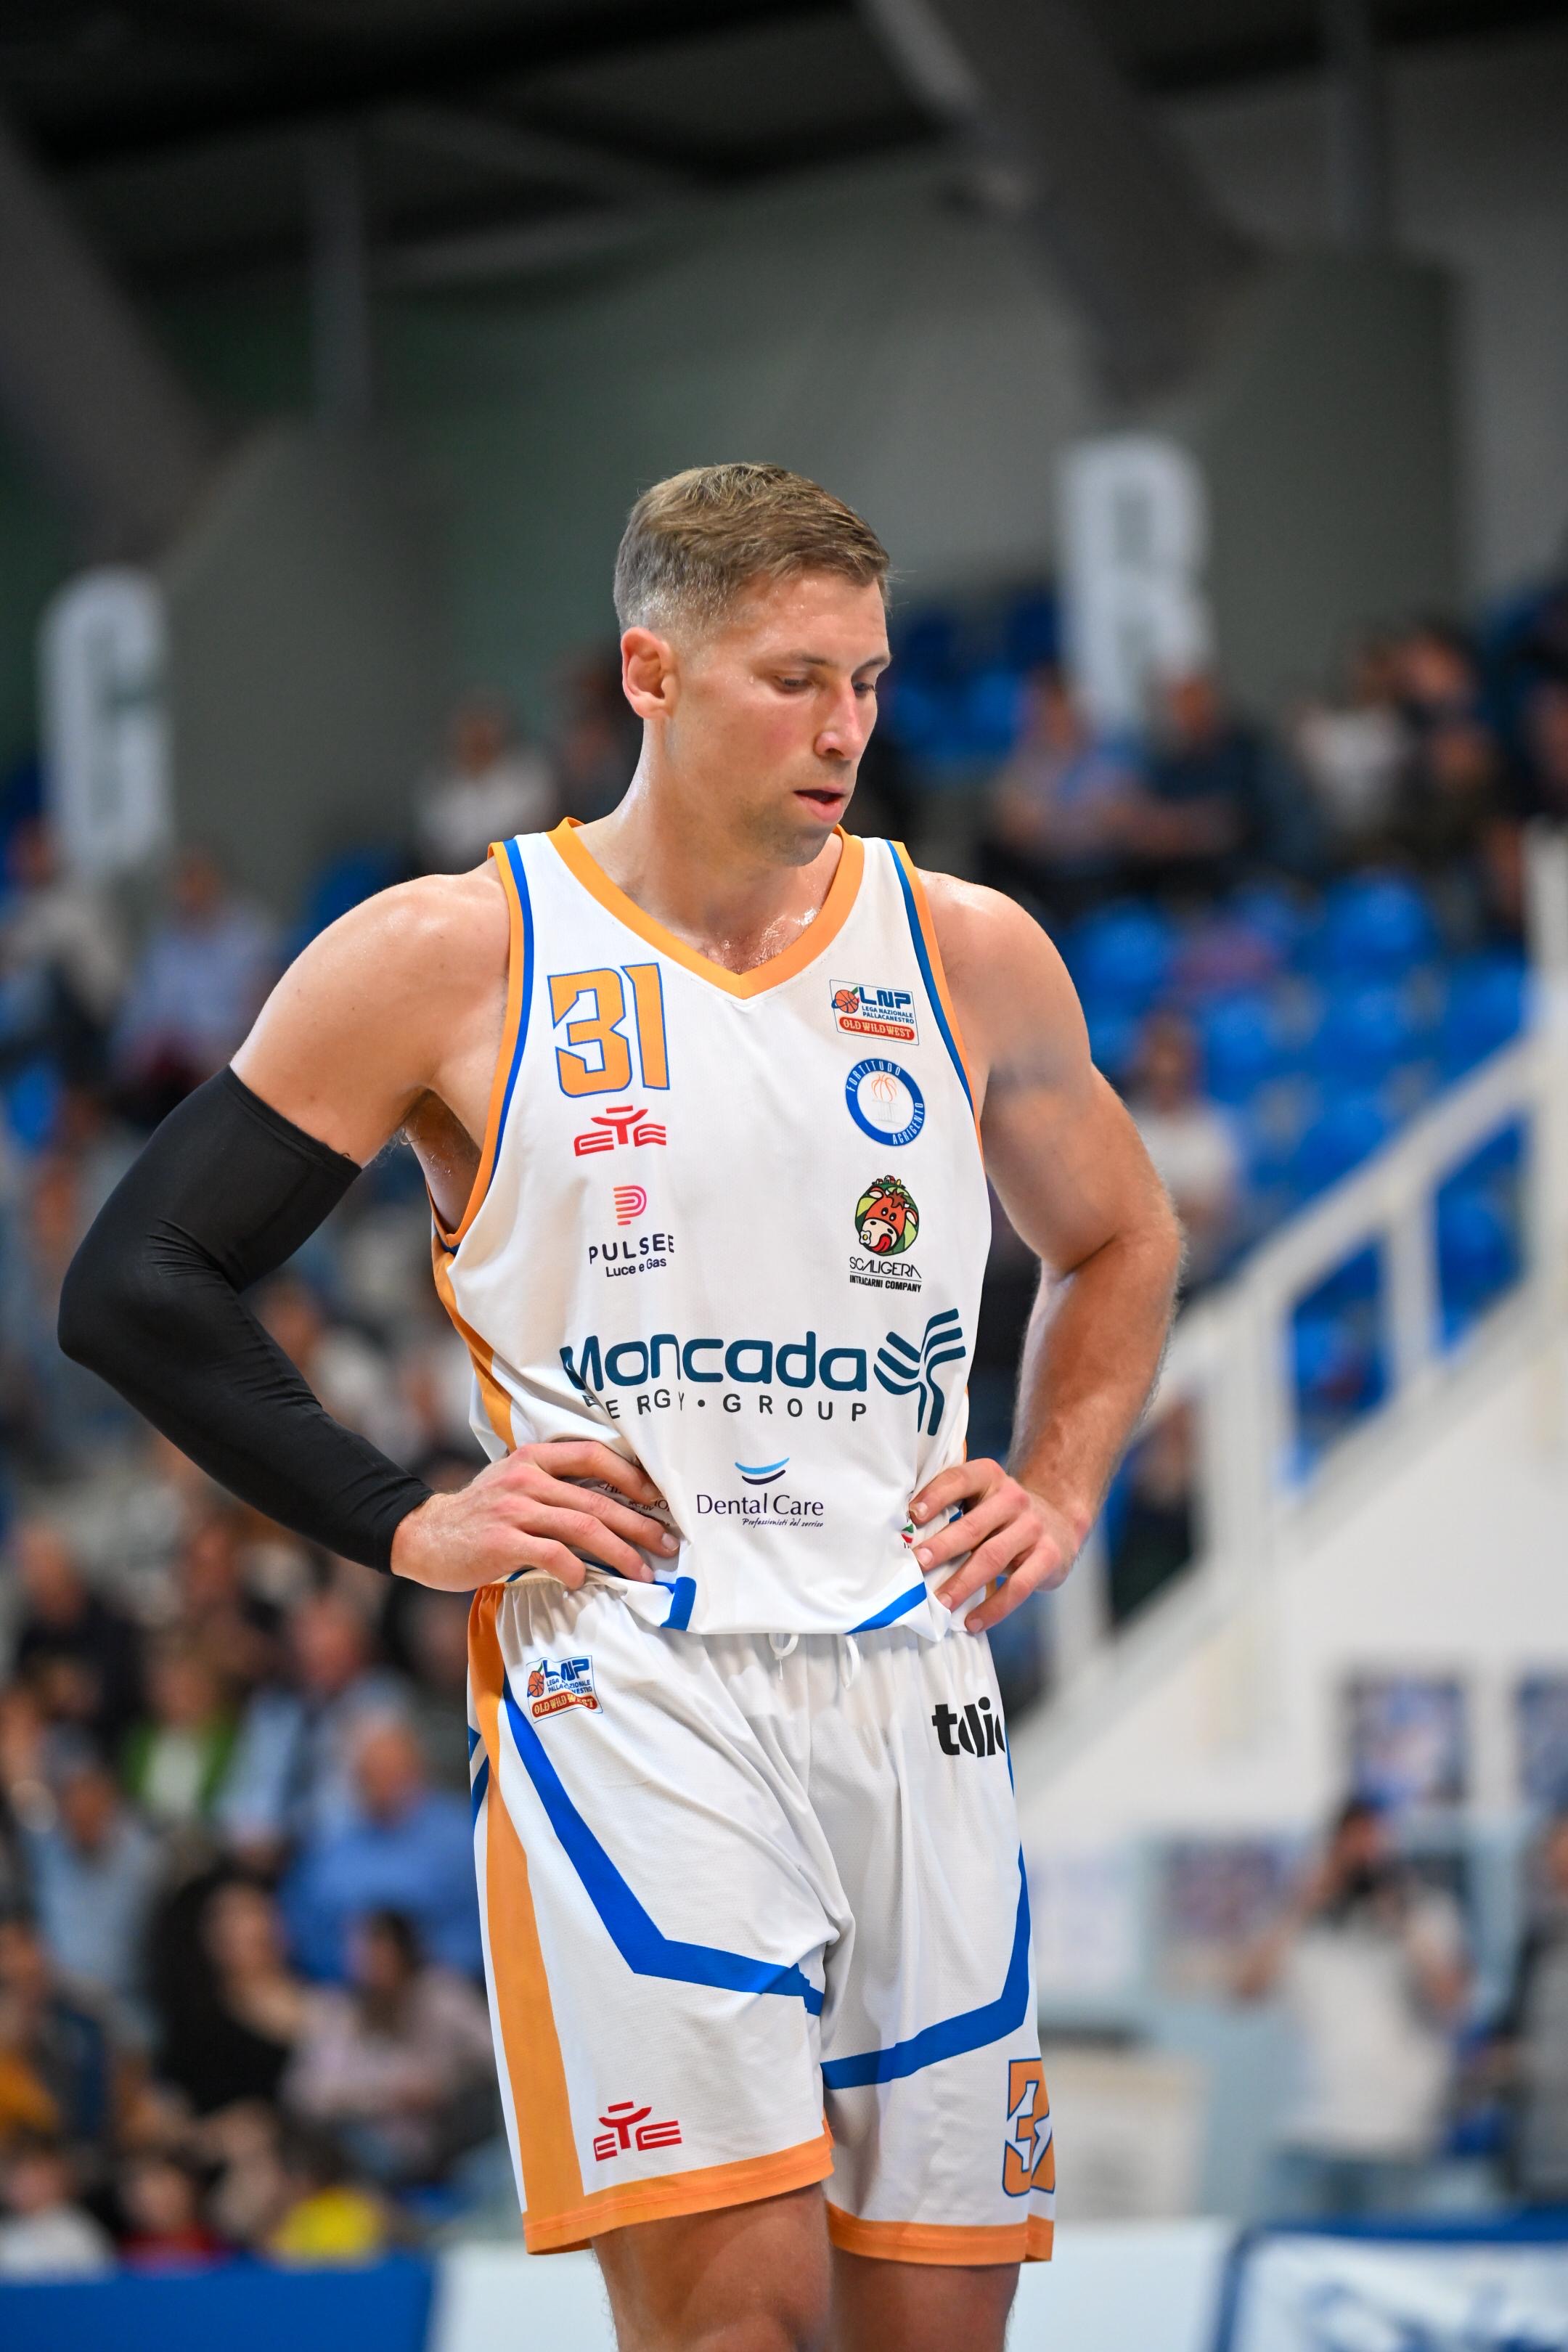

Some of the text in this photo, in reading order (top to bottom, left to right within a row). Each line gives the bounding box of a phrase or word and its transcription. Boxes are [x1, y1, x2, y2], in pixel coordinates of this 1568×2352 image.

[859, 986, 911, 1009] LNP
[862, 1011, 915, 1024] PALLACANESTRO
[879, 1008, 912, 1018] NAZIONALE
[547, 963, 670, 1098] 31
[844, 1019, 912, 1038] OLD WILD WEST
[846, 1061, 900, 1093] FORTITUDO
[589, 1233, 674, 1265] PULSEE
[605, 1258, 667, 1278] Luce e Gas
[849, 1257, 922, 1278] SCALIGERA
[885, 1281, 922, 1293] COMPANY
[560, 1331, 867, 1392] Moncada
[581, 1389, 867, 1421] EERGY GROUP
[696, 1493, 768, 1514] Dental
[772, 1494, 824, 1516] Care
[742, 1517, 788, 1528] Professionisti
[542, 1659, 589, 1681] LNP
[547, 1678, 560, 1687] LEGA
[534, 1702, 550, 1714] OLD
[550, 1695, 567, 1709] WILD
